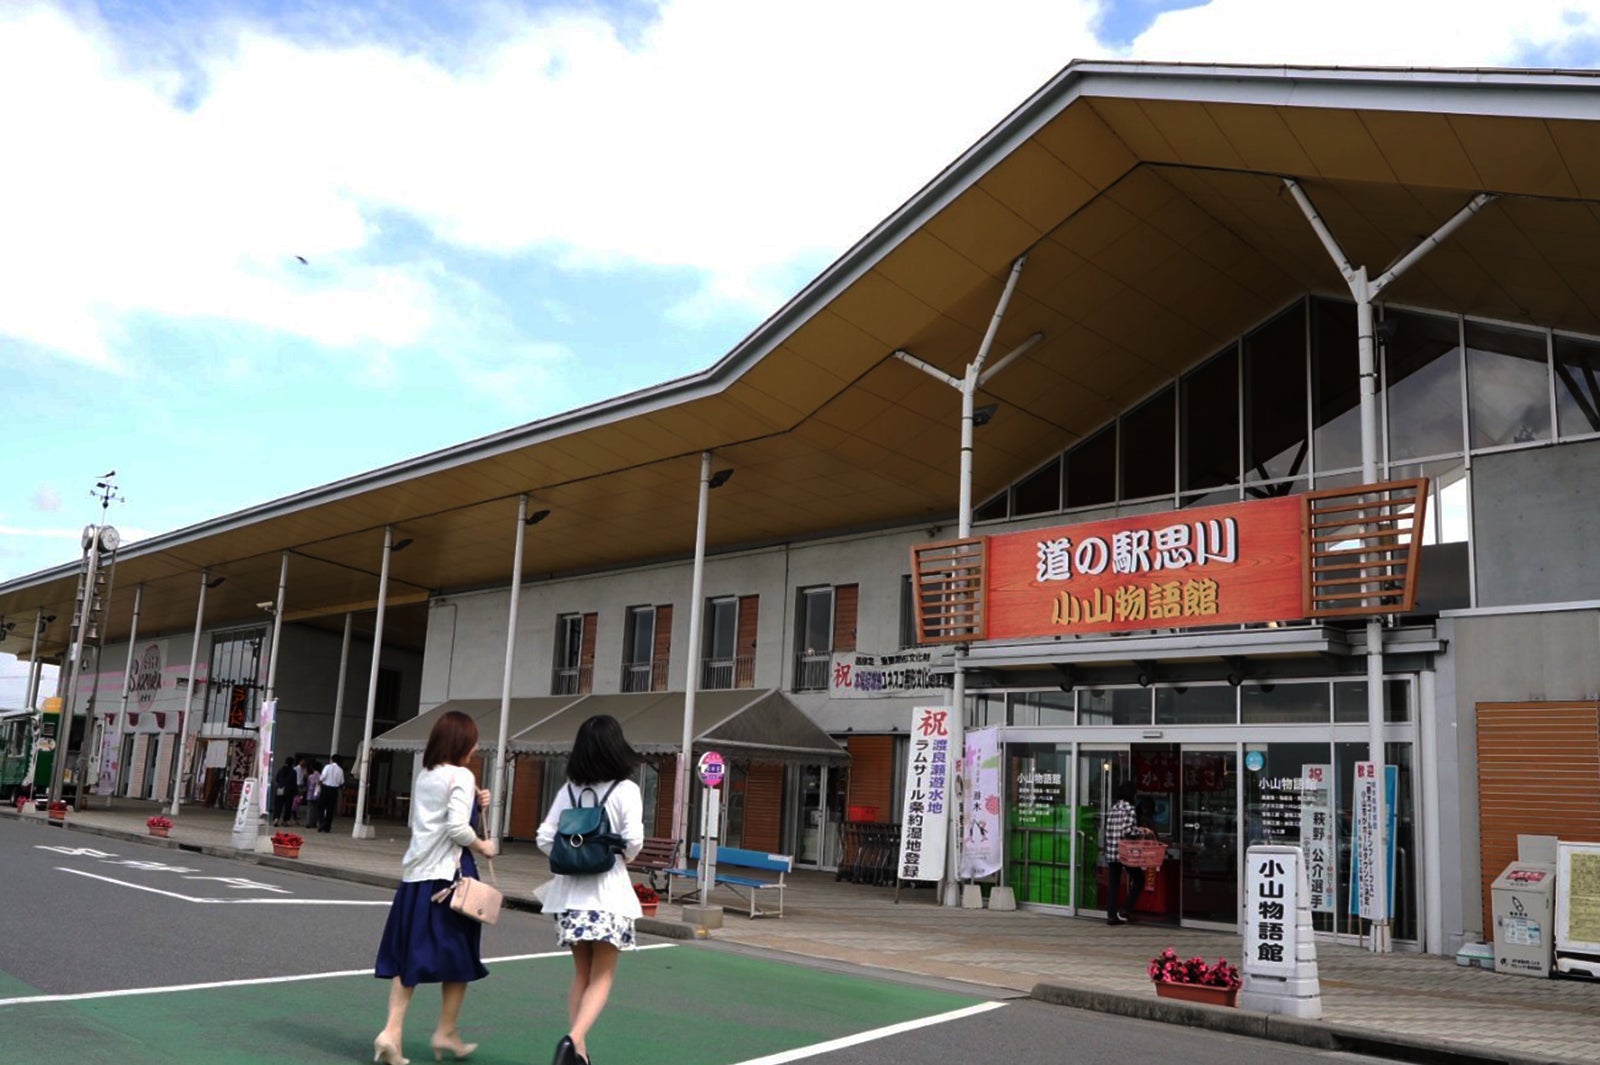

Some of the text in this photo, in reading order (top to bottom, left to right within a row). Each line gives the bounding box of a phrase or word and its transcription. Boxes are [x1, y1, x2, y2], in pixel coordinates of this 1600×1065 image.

[1036, 517, 1239, 582] 道の駅思川
[1051, 577, 1219, 626] 小山物語館
[834, 661, 852, 689] 祝
[917, 710, 948, 737] 祝
[927, 739, 948, 814] 渡良瀬遊水地
[1017, 772, 1061, 784] 小山物語館
[1308, 767, 1323, 783] 祝
[1357, 764, 1375, 779] 歓迎
[903, 739, 929, 877] ラムサール条約湿地登録
[1258, 859, 1284, 962] 小山物語館
